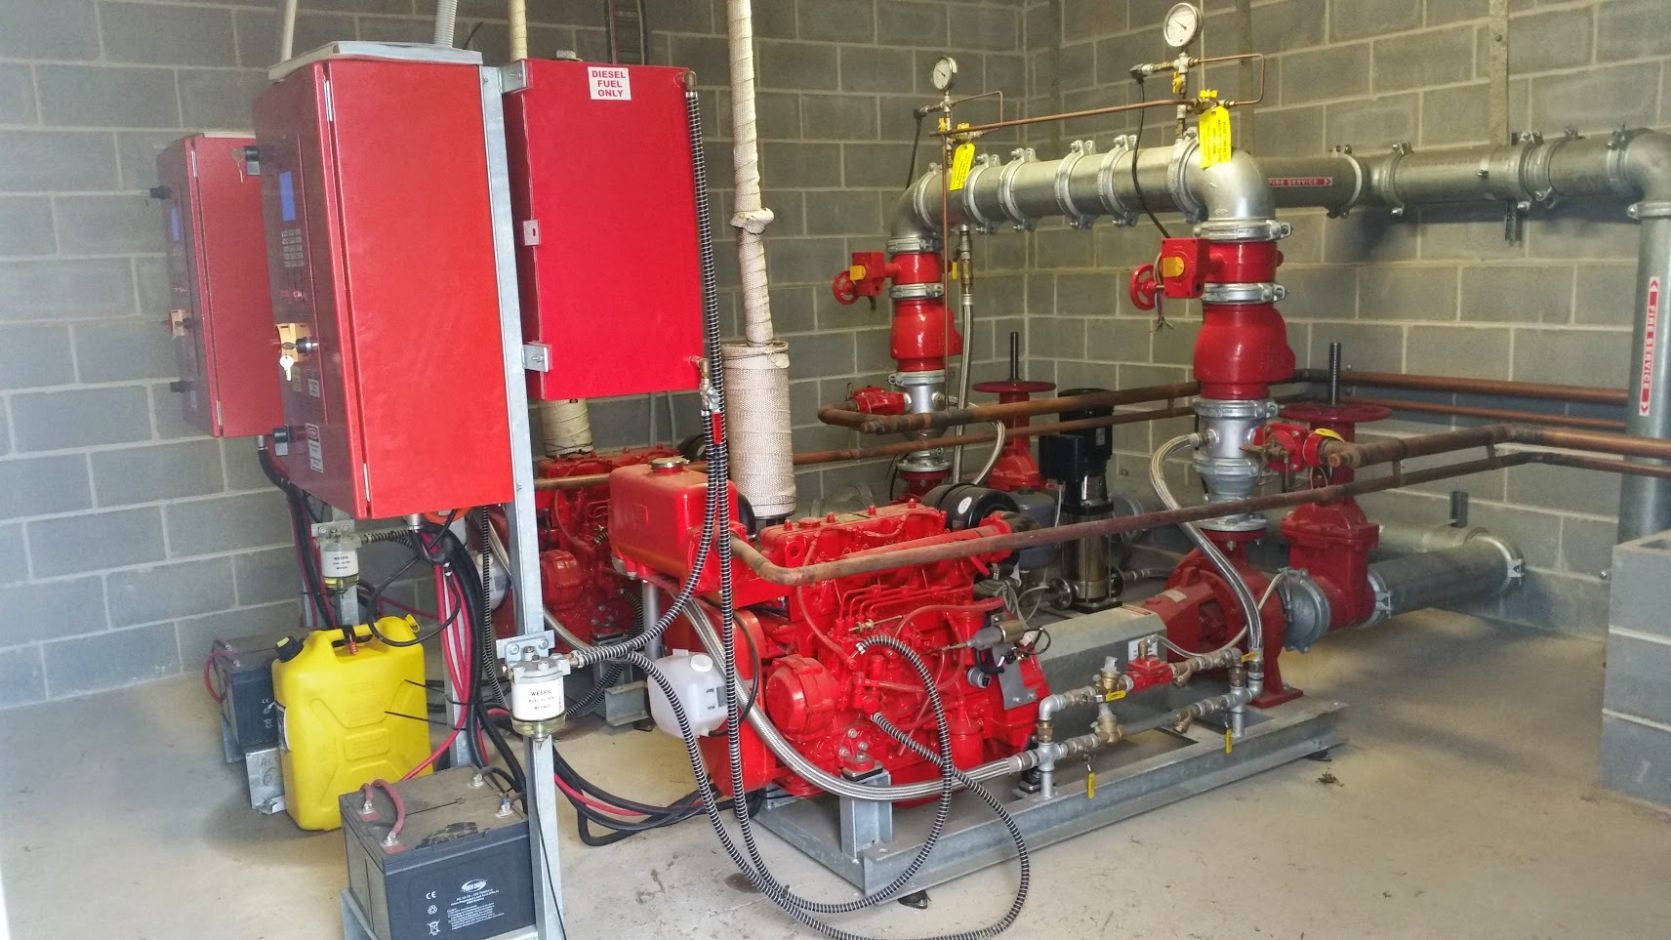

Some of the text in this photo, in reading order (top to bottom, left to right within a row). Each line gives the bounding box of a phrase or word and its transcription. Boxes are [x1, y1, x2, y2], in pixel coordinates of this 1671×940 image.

[592, 70, 626, 78] DIESEL
[598, 89, 623, 97] ONLY
[1643, 304, 1656, 390] FIRE SERVICE
